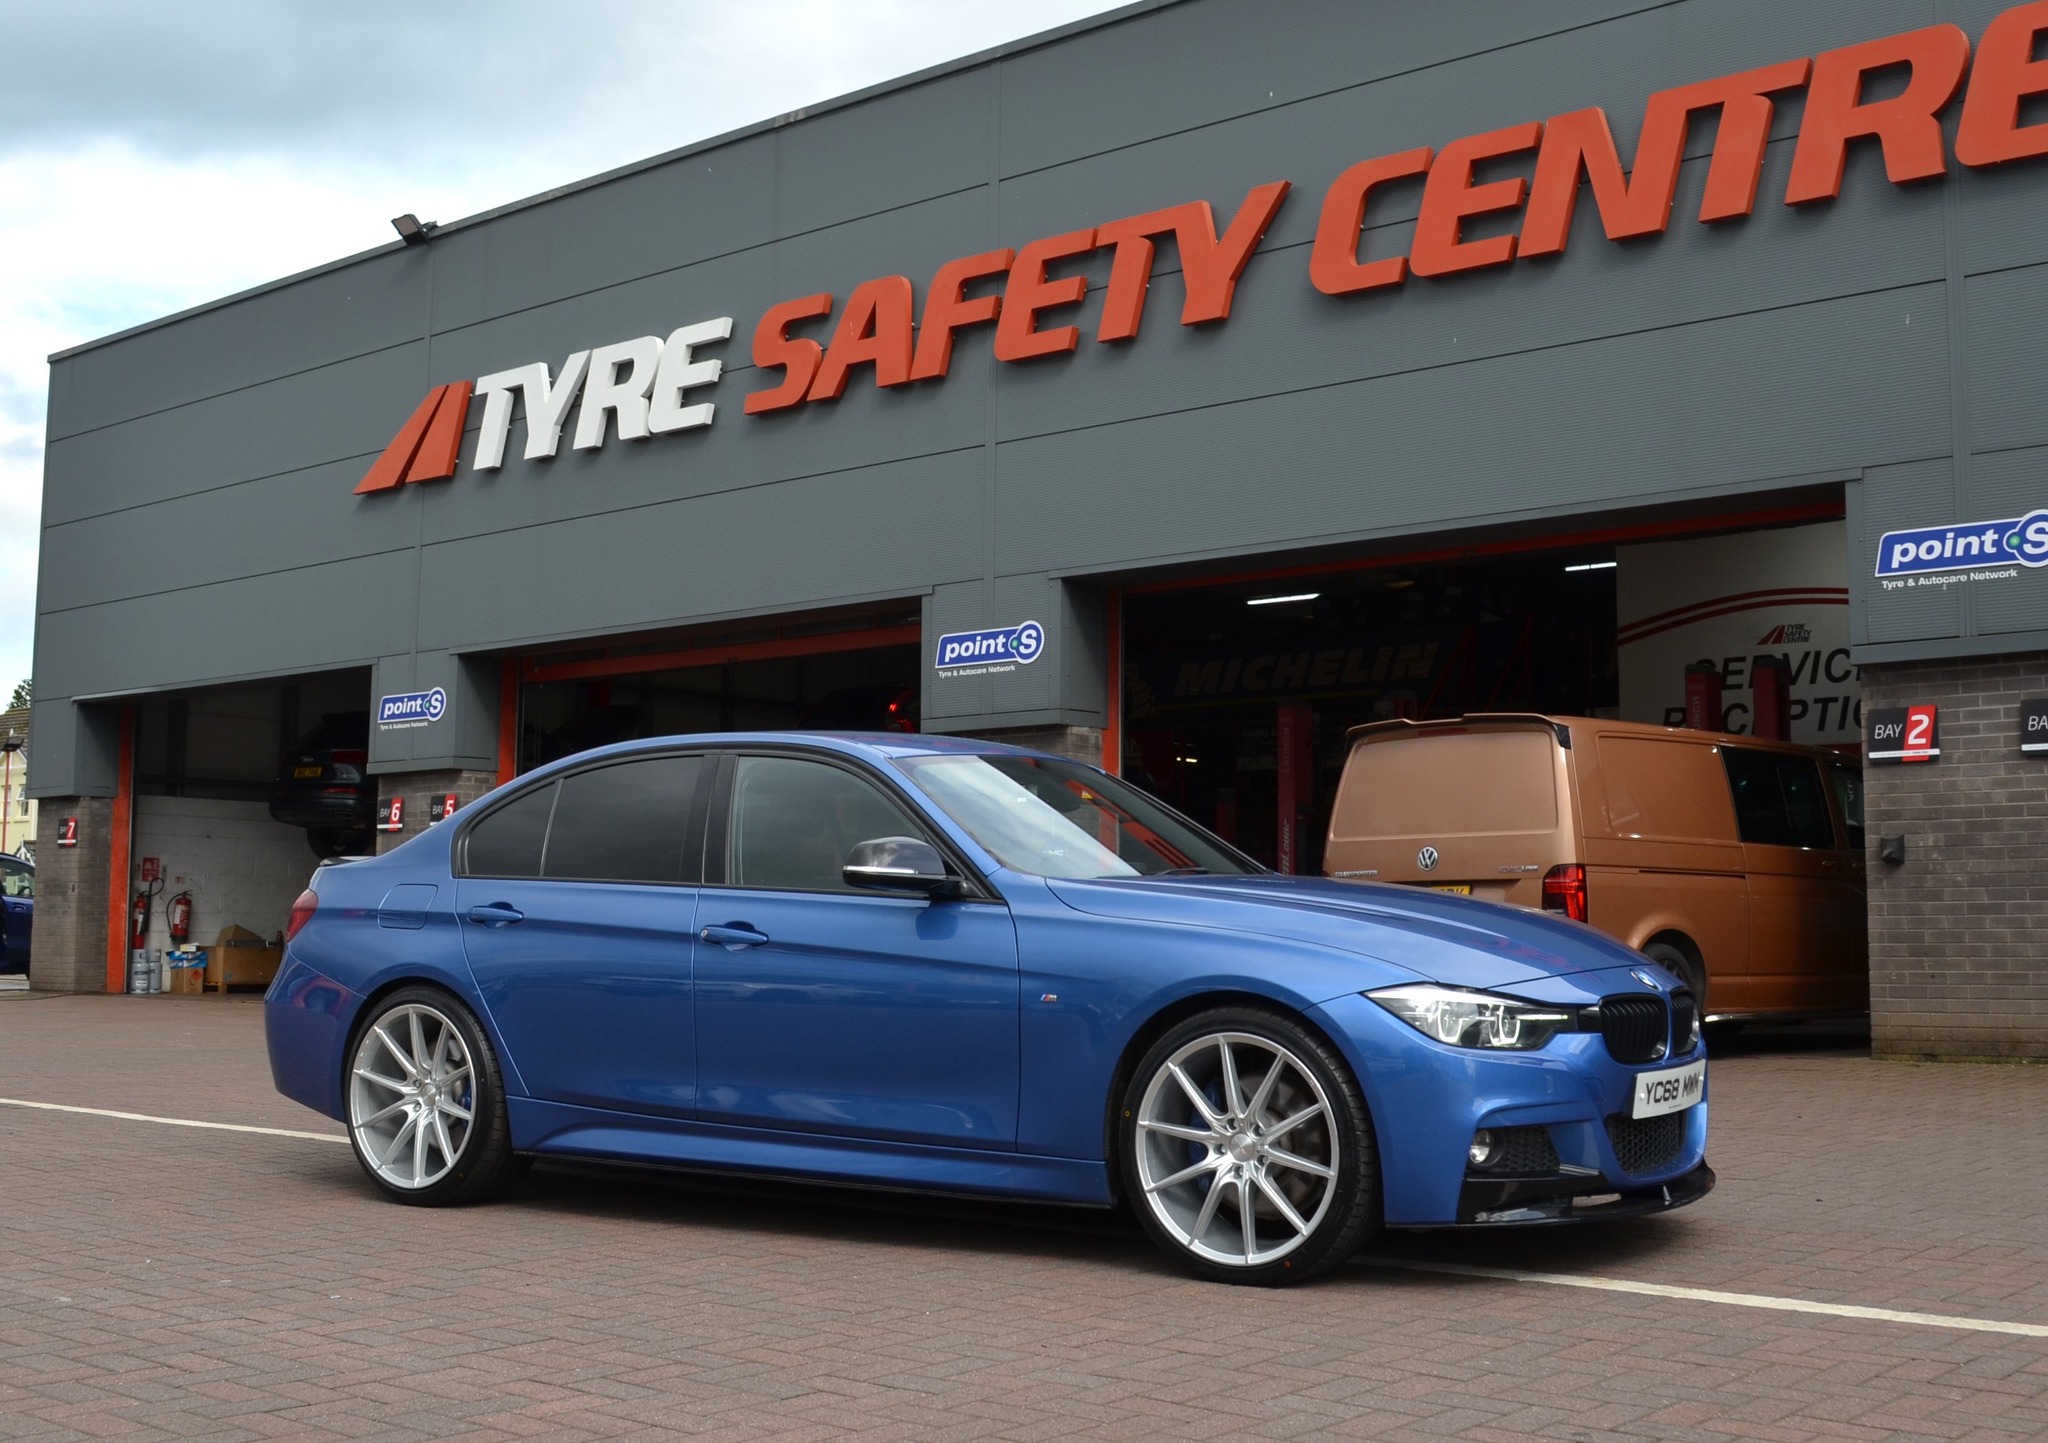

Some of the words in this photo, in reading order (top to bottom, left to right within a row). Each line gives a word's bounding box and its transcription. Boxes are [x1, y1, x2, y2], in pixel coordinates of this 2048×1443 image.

[473, 316, 733, 470] TYRE
[743, 180, 1292, 416] SAFETY
[1309, 0, 2048, 295] CENTRE
[1891, 528, 1999, 569] point
[2023, 521, 2048, 555] S
[1881, 580, 1905, 591] Tyre
[1907, 578, 1915, 587] &
[1918, 575, 1968, 586] Autocare
[1970, 569, 2018, 582] Network
[1785, 629, 1812, 637] SAFETY
[944, 634, 1006, 662] point
[1019, 629, 1038, 654] S
[938, 671, 952, 679] Tyre
[953, 669, 958, 677] &
[959, 668, 987, 676] Autocare
[988, 665, 1016, 673] Network
[1173, 642, 1439, 697] MICHELIN
[1695, 648, 1861, 691] EVIC
[384, 697, 422, 718] point
[429, 694, 442, 714] S
[1874, 724, 1903, 739] BAY
[1908, 714, 1930, 745] 2
[2028, 716, 2048, 731] BA
[380, 808, 391, 818] BAY
[391, 803, 401, 821] 6
[432, 806, 444, 815] BAY
[444, 800, 454, 818] 5
[68, 822, 75, 838] 7
[1646, 1078, 1680, 1105] YC68
